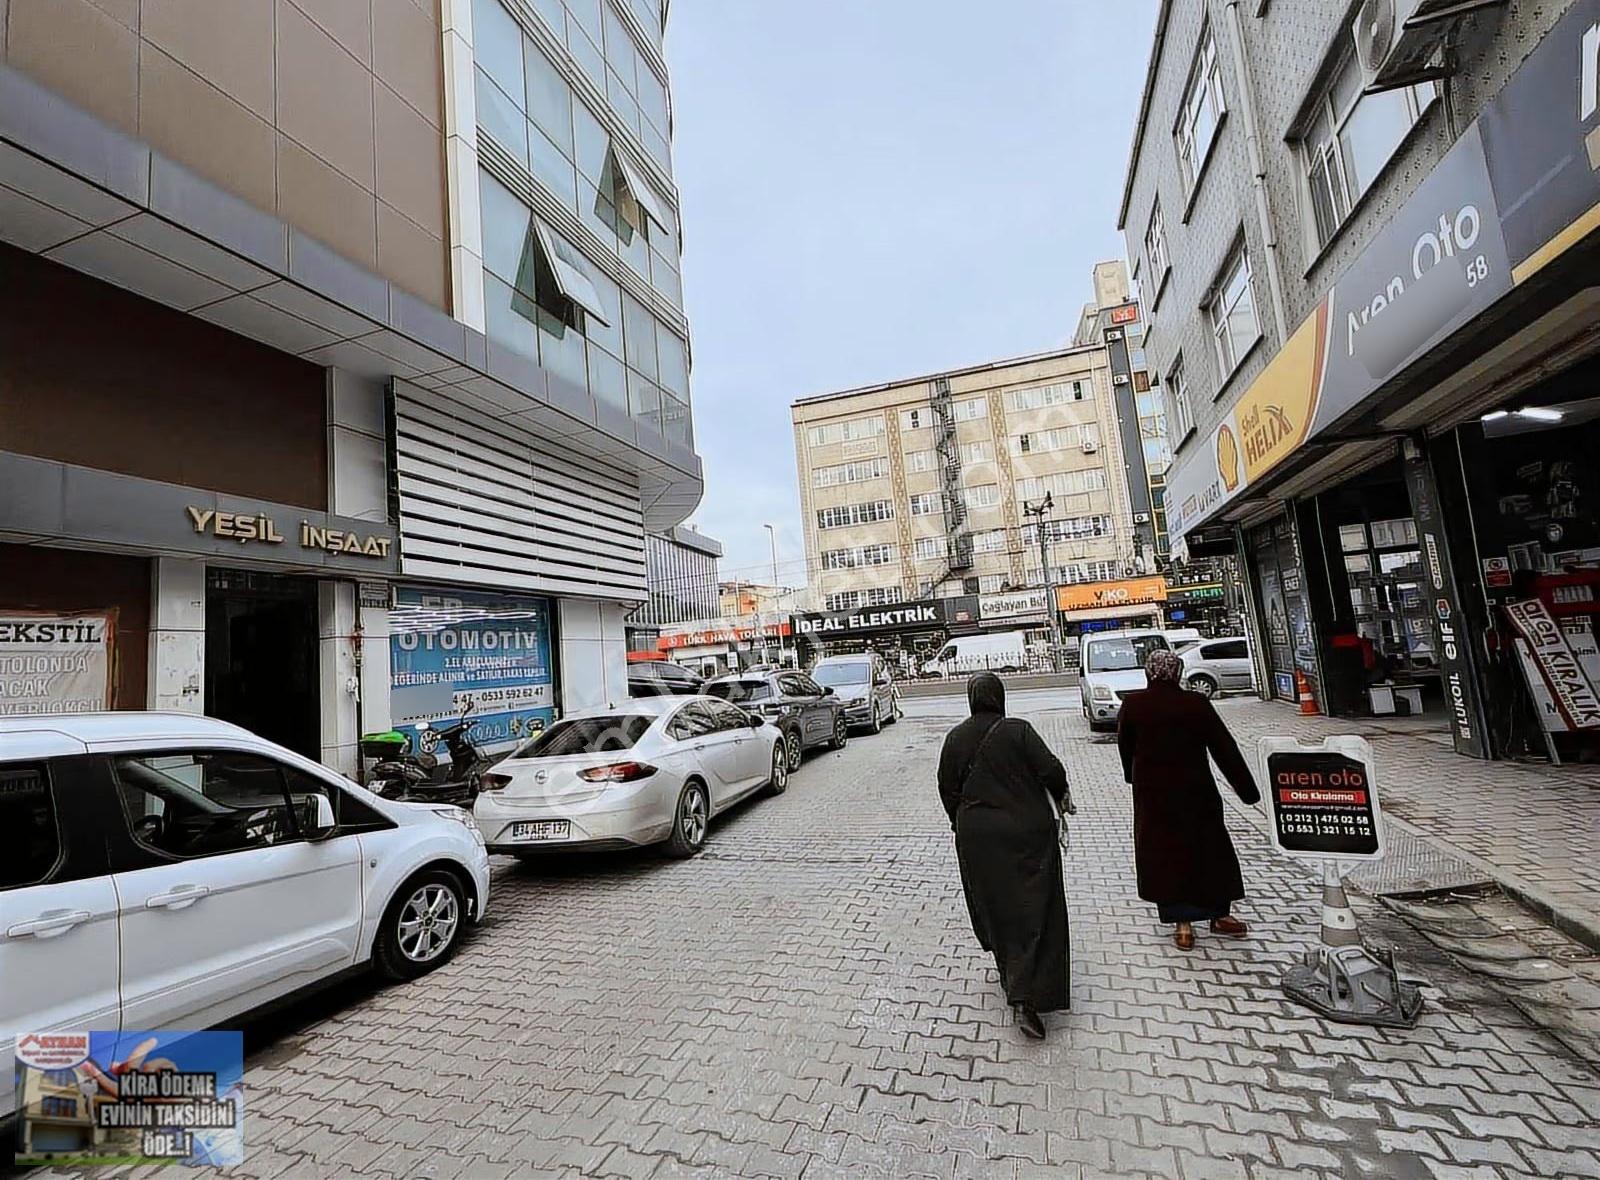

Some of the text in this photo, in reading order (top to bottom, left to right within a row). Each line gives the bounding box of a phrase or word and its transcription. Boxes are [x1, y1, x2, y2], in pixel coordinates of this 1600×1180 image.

[1412, 204, 1480, 280] Oto
[1466, 255, 1488, 288] 58
[1245, 405, 1294, 467] HELIX
[188, 506, 392, 557] YEŞİL İNŞAAT
[849, 605, 937, 628] ELEKTRİK
[399, 627, 537, 651] OTOMOTİV
[1440, 621, 1458, 661] elf
[1449, 672, 1469, 730] LUKOIL
[1277, 768, 1363, 786] aren oto
[1290, 791, 1309, 800] Oto
